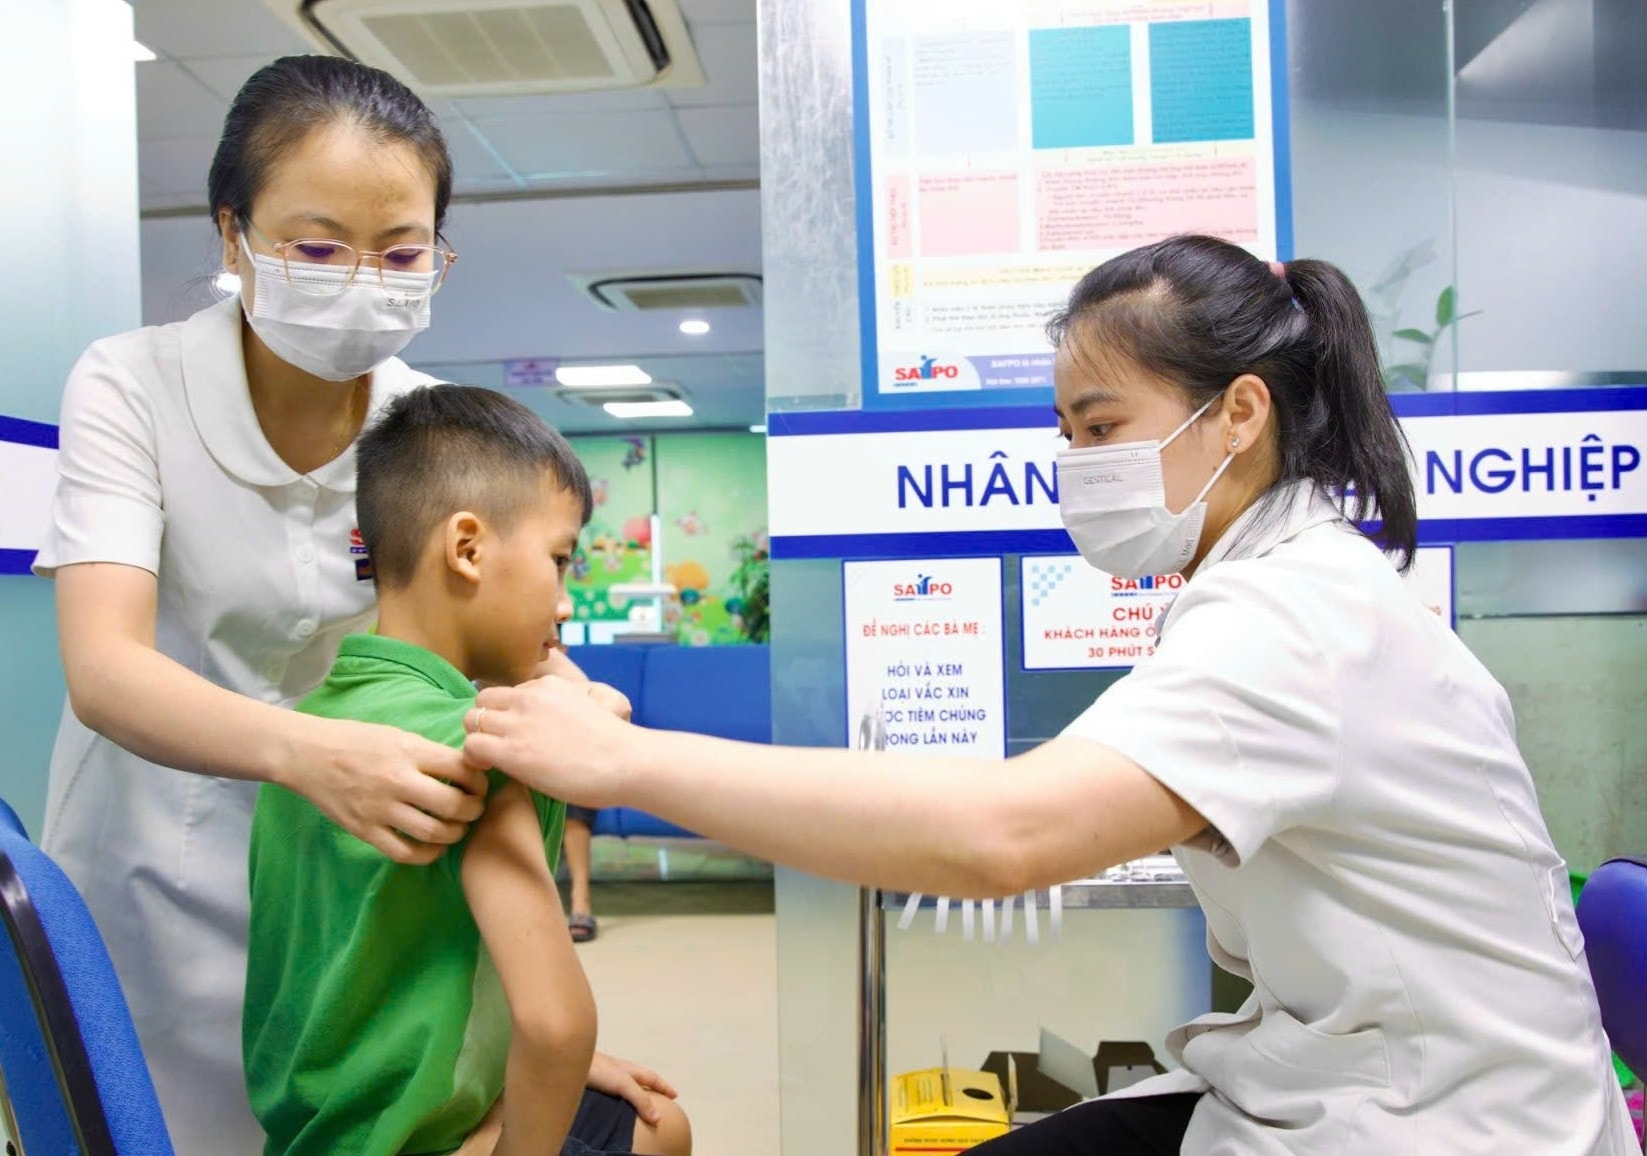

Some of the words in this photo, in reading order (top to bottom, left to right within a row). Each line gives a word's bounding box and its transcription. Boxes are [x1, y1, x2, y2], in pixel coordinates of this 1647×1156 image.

[898, 450, 1058, 508] NHÂN
[1427, 433, 1641, 501] NGHIỆP
[1112, 603, 1153, 620] CHÚ
[1044, 626, 1095, 640] KHÁCH
[1100, 625, 1140, 639] HÀNG
[1088, 647, 1104, 658] 30
[1109, 644, 1143, 657] PHÚT
[937, 664, 963, 677] XEM
[882, 687, 911, 704] LOẠI
[948, 687, 969, 698] XIN
[908, 707, 935, 722] TIÊM
[885, 732, 919, 745] RONG
